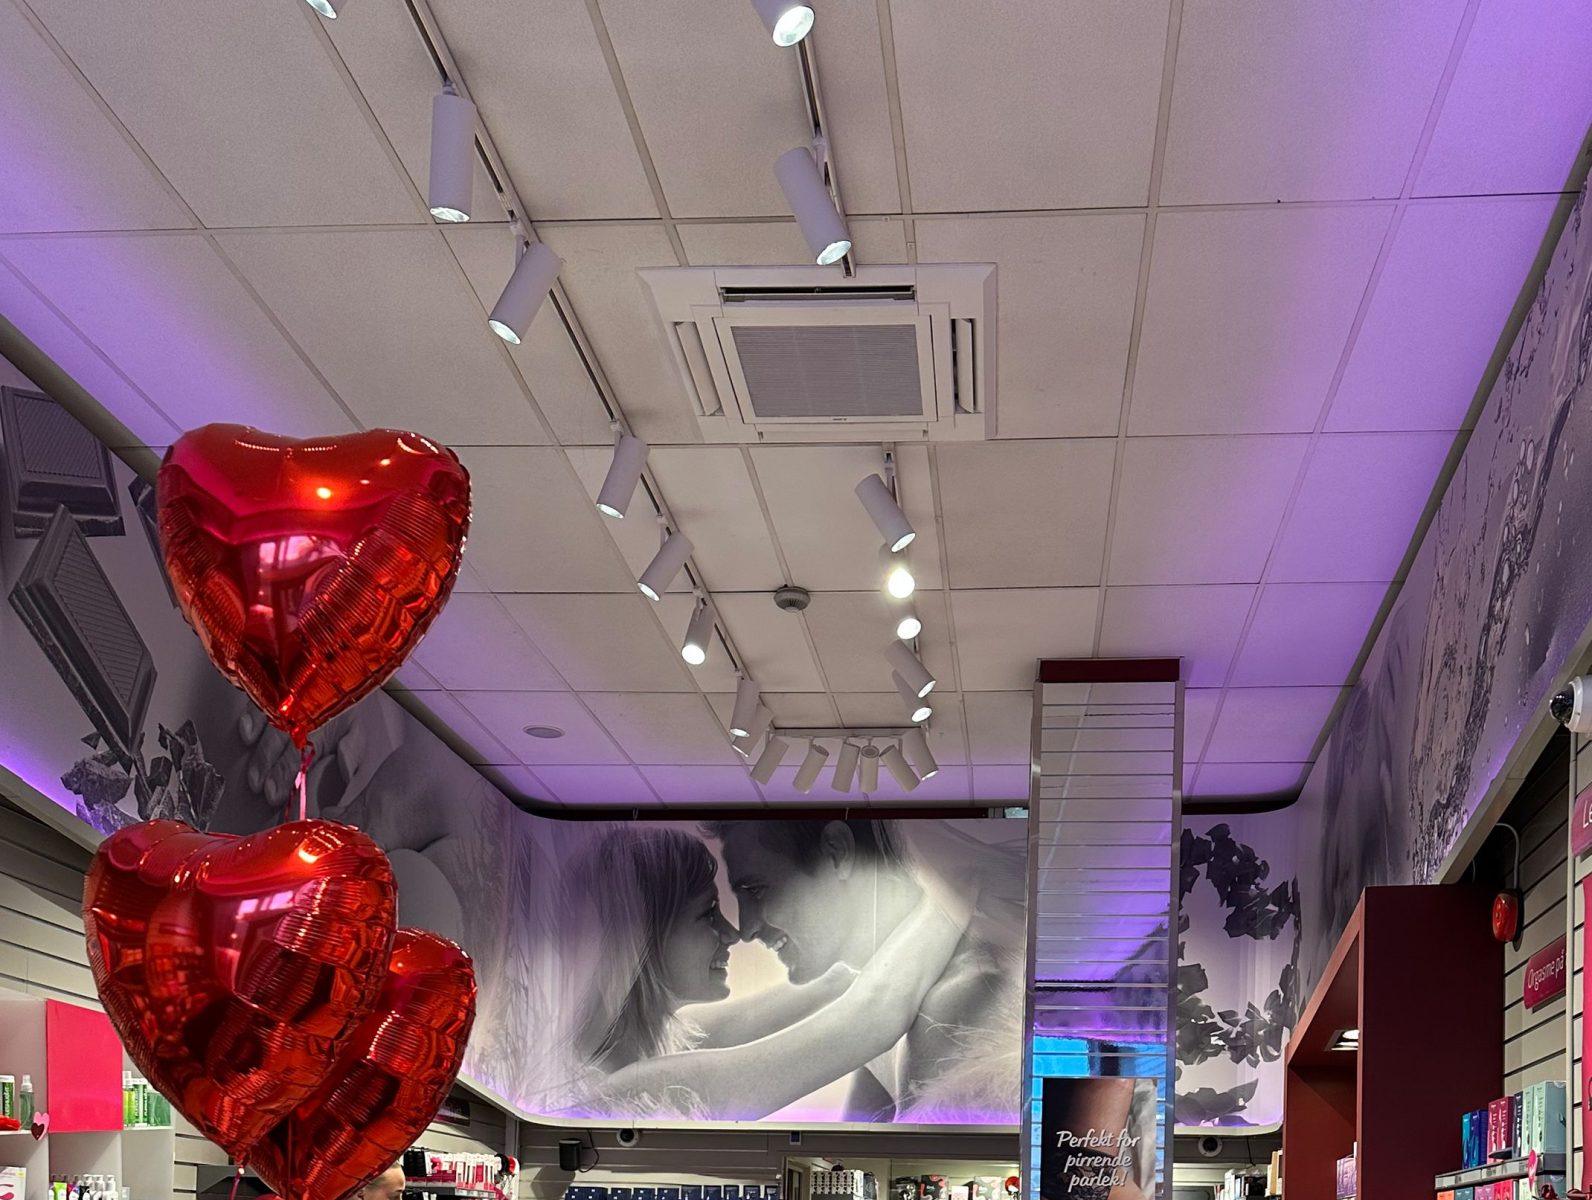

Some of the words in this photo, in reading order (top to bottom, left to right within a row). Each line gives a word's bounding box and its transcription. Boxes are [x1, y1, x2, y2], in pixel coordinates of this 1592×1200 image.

[1528, 960, 1555, 991] Orgasme
[1056, 1128, 1115, 1148] Perfekt
[1116, 1128, 1141, 1148] for
[1063, 1151, 1132, 1173] pirrende
[1067, 1168, 1128, 1193] parlek!
